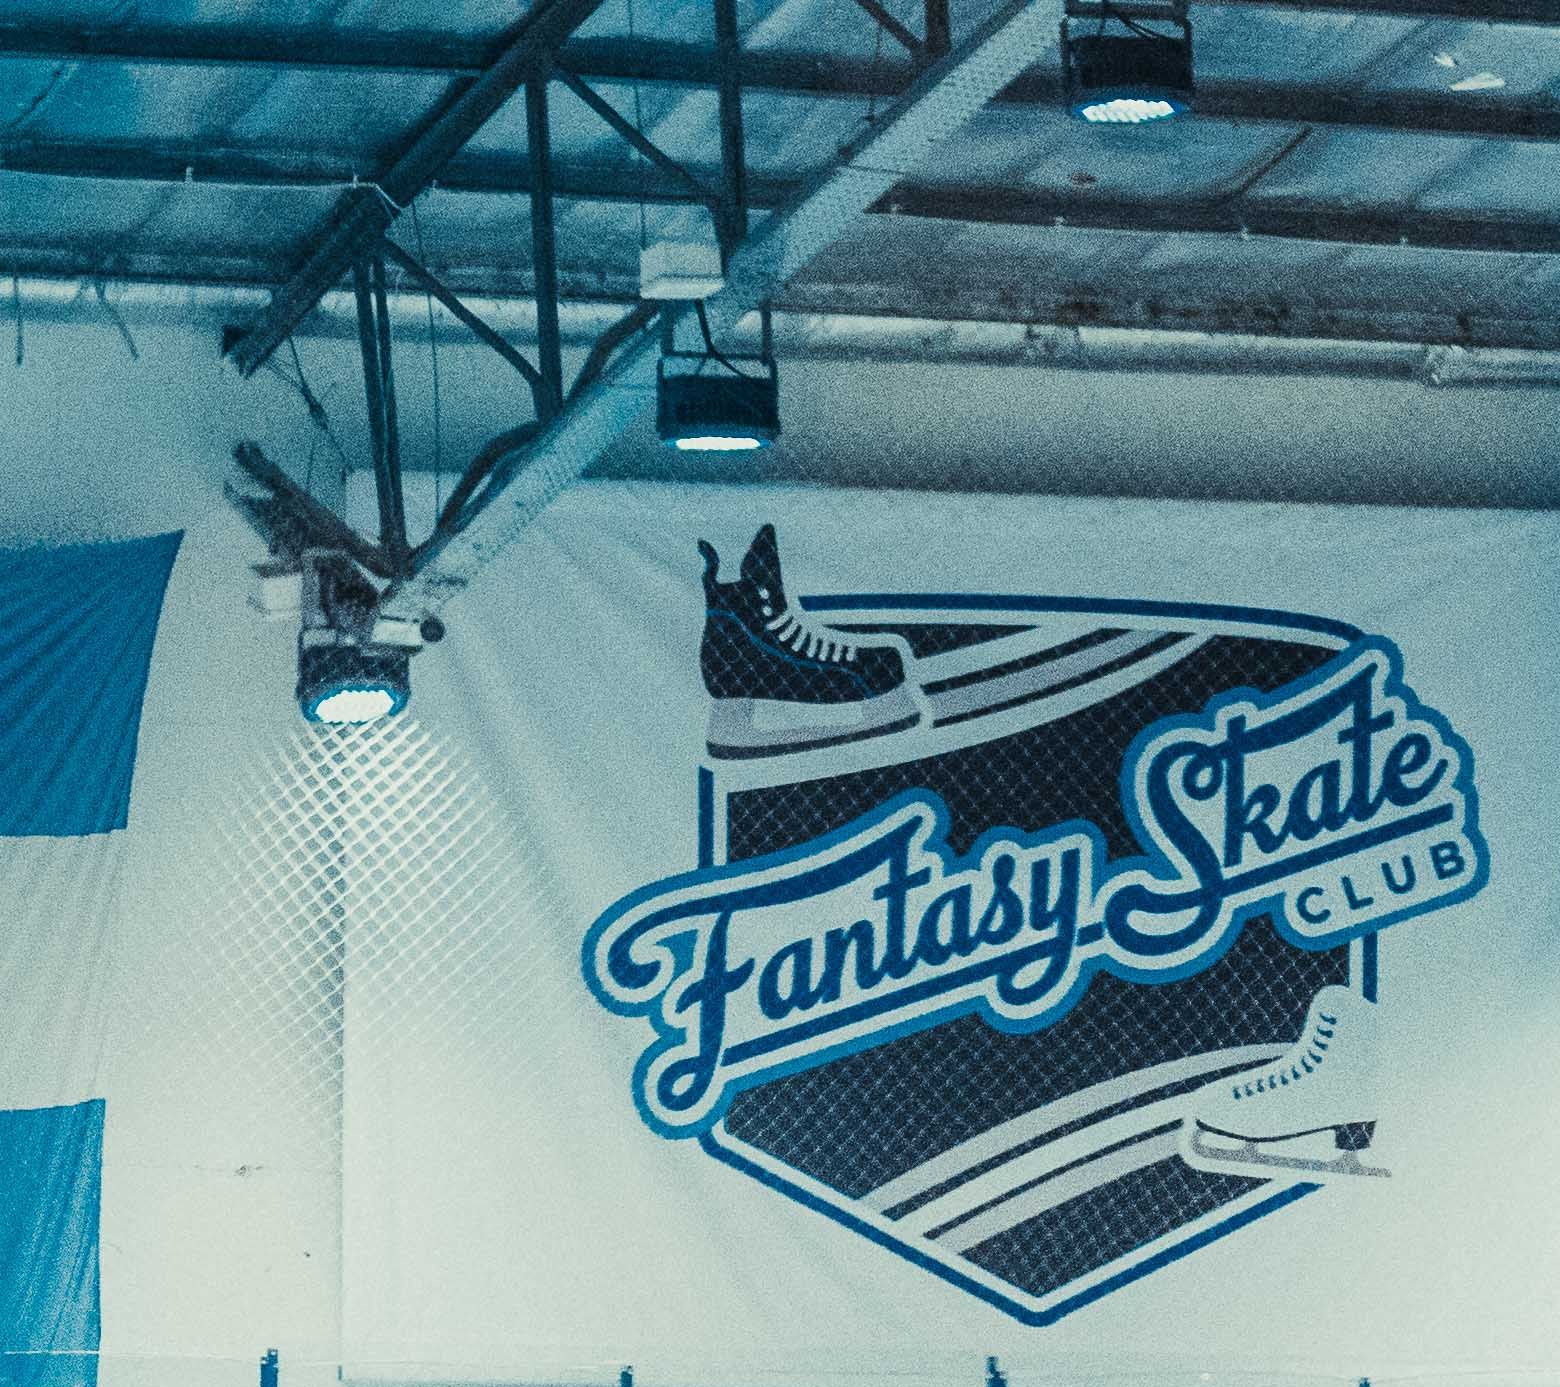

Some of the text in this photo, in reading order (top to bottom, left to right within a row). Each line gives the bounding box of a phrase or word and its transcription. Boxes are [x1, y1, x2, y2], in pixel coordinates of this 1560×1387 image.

[605, 661, 1457, 1107] Fantasy Skate
[1294, 838, 1467, 926] CLUB
